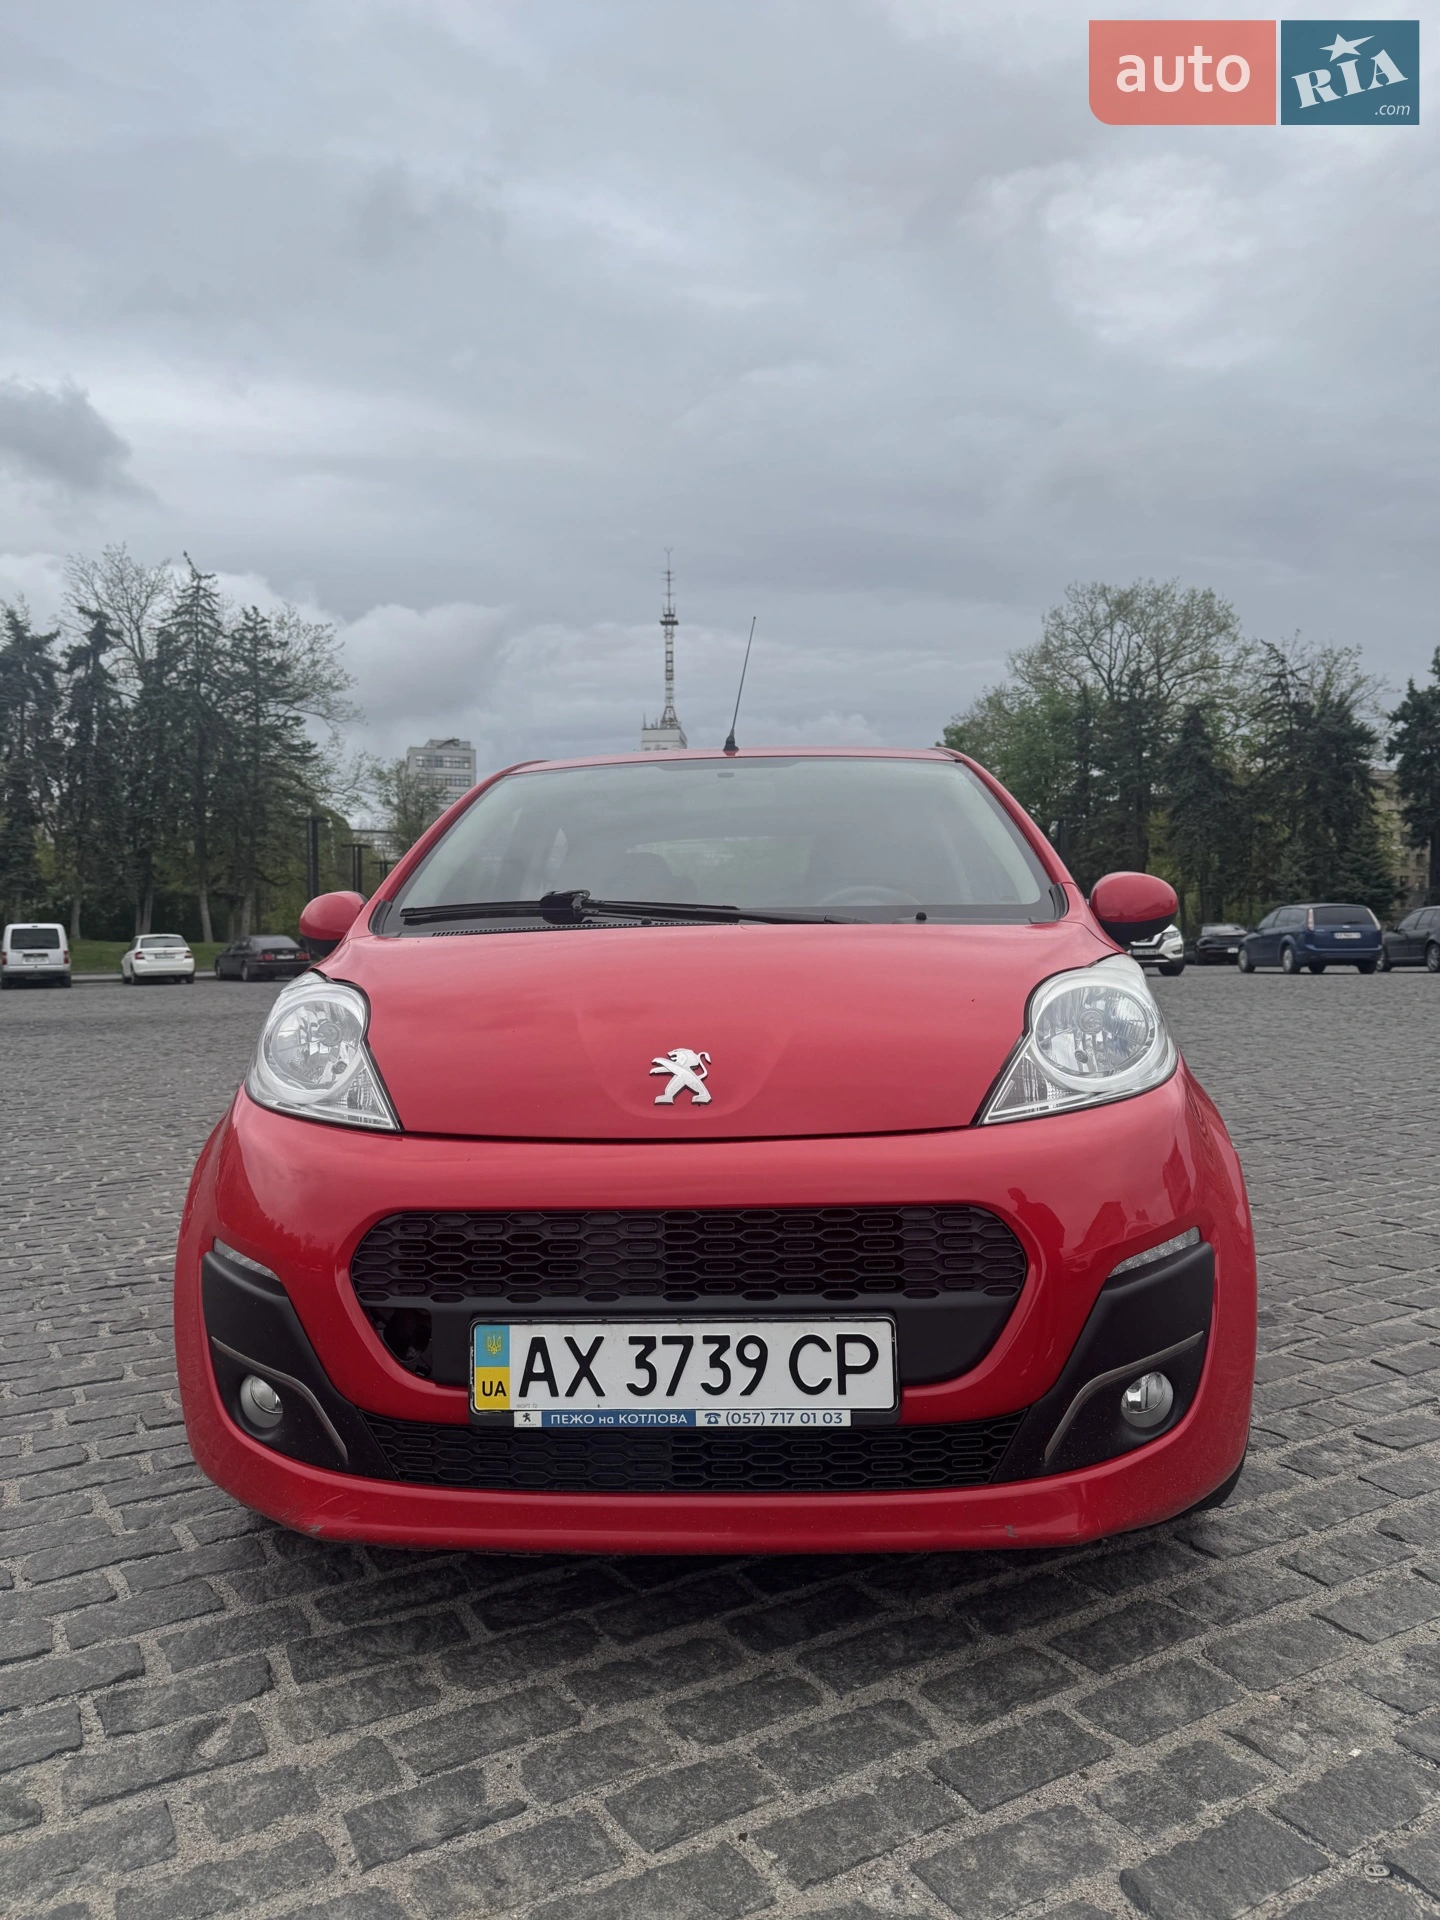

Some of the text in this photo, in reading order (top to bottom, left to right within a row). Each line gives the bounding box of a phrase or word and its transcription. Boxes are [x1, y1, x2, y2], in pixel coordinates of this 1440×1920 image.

[518, 1334, 879, 1398] AX 3739 CP
[482, 1380, 507, 1398] UA
[551, 1411, 842, 1426] ПЕЖО на КОТЛОВА (057) 717 01 03
